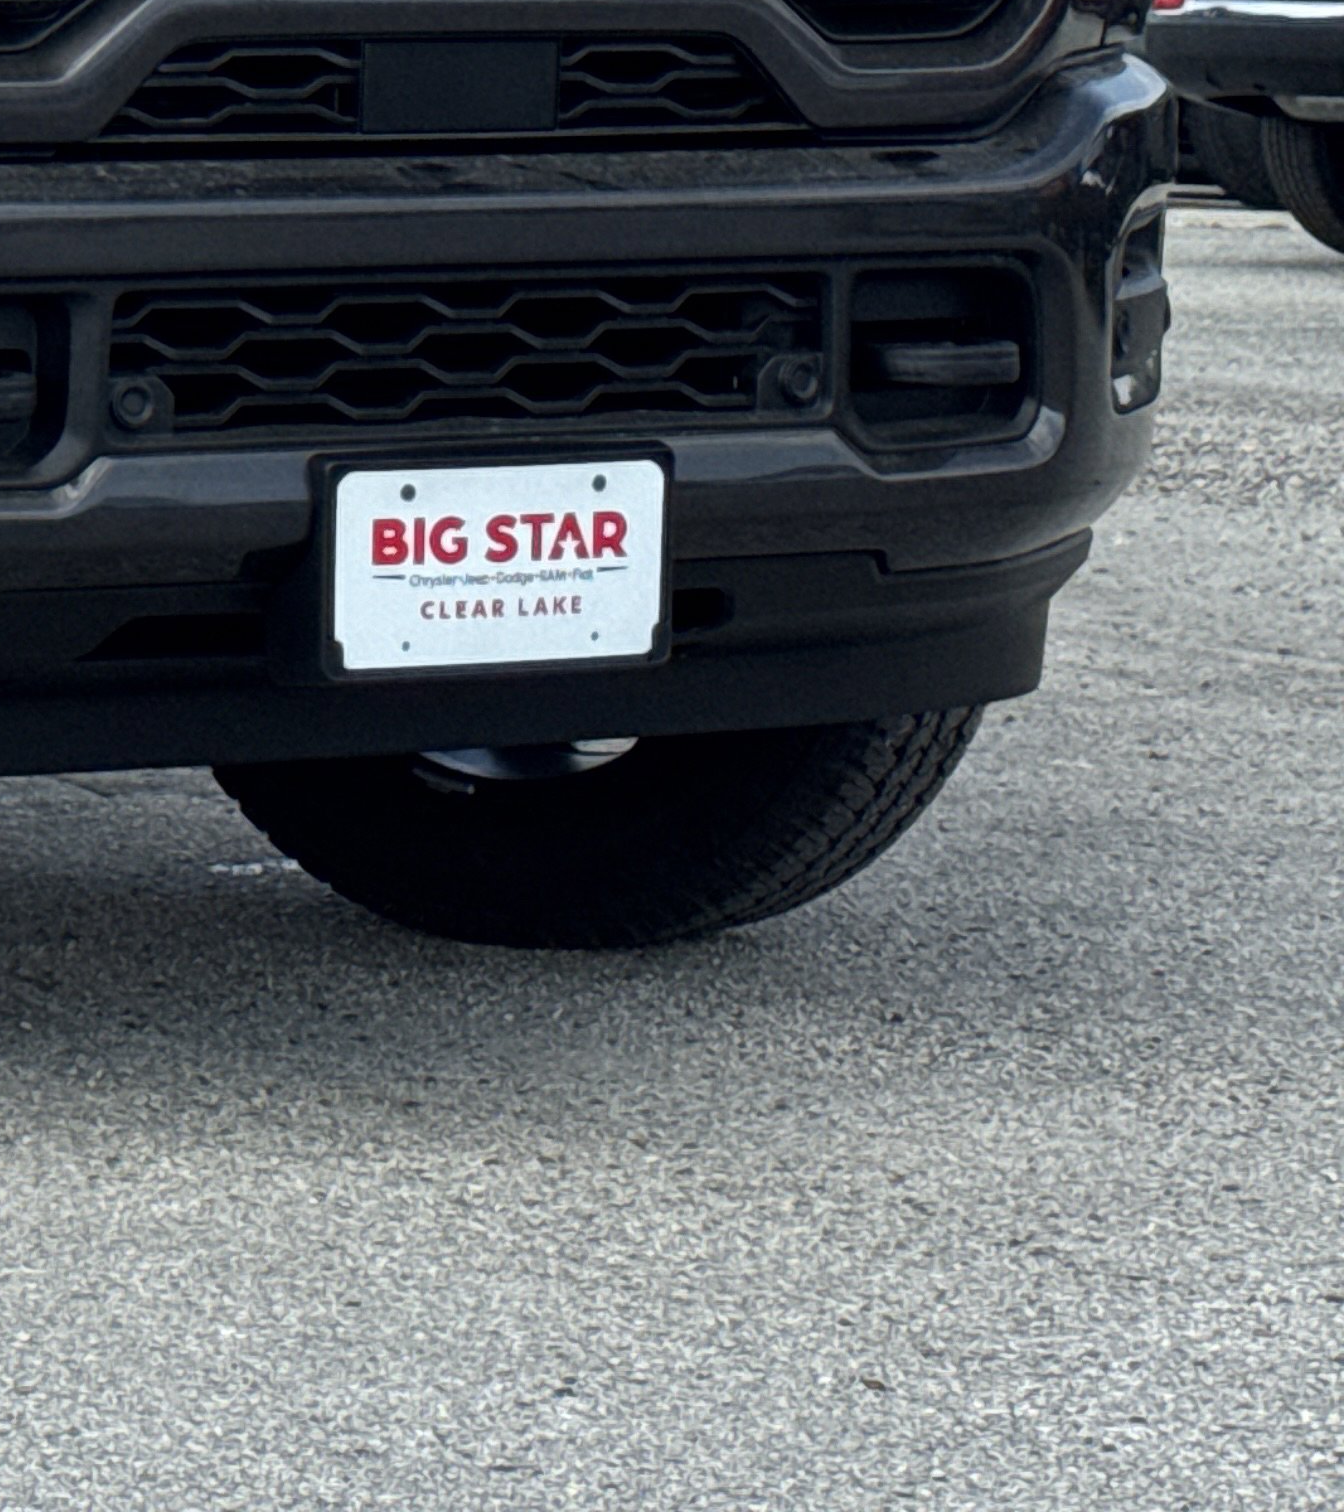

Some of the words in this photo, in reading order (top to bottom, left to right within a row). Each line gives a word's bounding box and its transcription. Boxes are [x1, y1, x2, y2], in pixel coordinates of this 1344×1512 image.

[372, 516, 469, 566] BIG
[484, 510, 628, 563] STAR
[420, 599, 505, 621] CLEAR
[518, 595, 583, 617] LAKE
